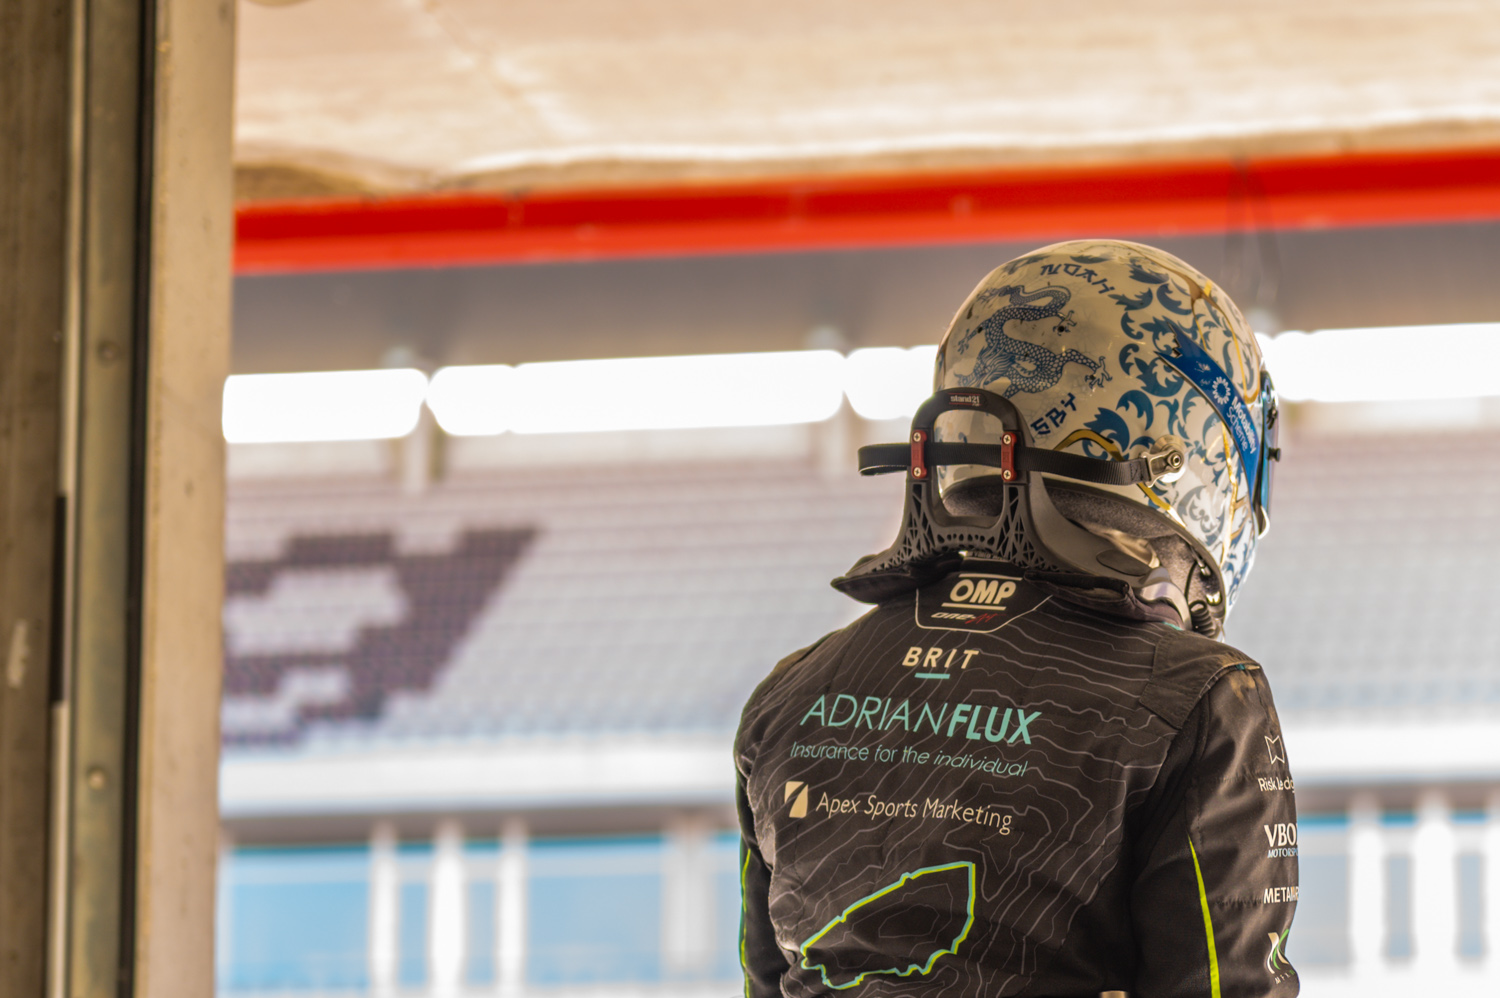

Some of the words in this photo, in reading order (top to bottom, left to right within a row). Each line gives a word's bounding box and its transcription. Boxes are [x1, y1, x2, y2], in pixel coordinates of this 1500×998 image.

[1030, 392, 1077, 436] SBY
[1226, 406, 1249, 451] Scheme
[1231, 396, 1258, 454] Motability
[949, 579, 1017, 604] OMP
[902, 646, 980, 669] BRIT
[789, 741, 870, 761] Insurance
[874, 744, 897, 763] for
[902, 746, 930, 764] the
[933, 750, 1028, 777] individual
[815, 791, 859, 819] Apex
[863, 795, 918, 820] Sports
[922, 797, 1012, 836] Marketing
[1263, 822, 1298, 848] VBO
